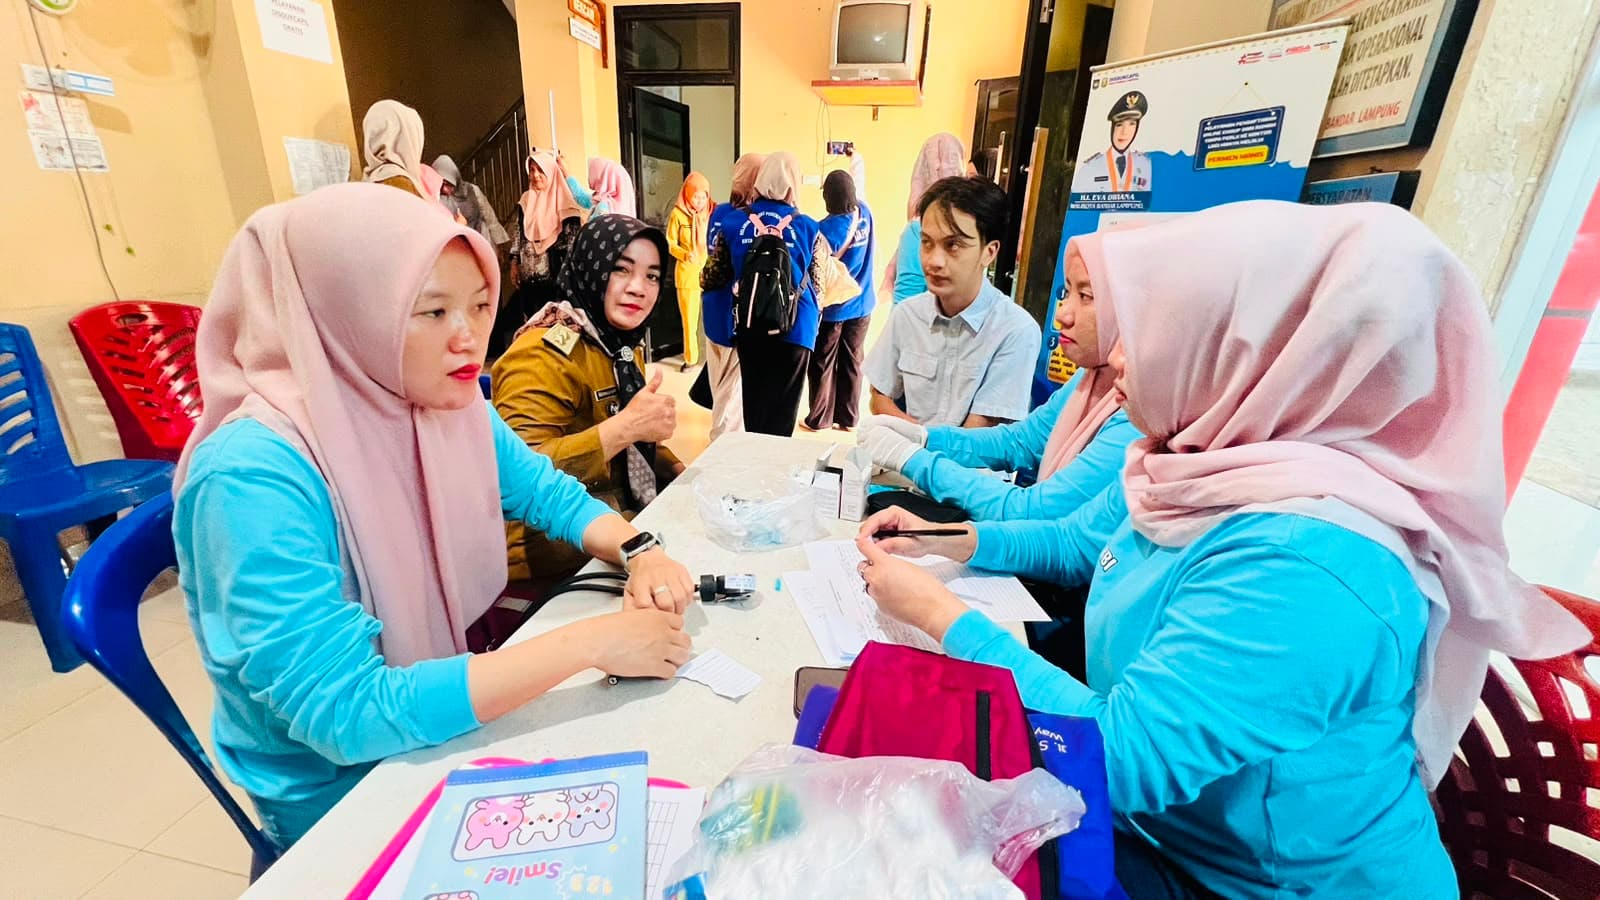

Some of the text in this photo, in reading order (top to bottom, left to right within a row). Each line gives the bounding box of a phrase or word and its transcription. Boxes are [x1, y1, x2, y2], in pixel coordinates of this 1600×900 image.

[1356, 14, 1428, 61] OPERASIONAL
[1358, 100, 1402, 123] LAMPUNG
[1307, 187, 1373, 205] ERSYARATAN
[1034, 727, 1065, 743] Way
[484, 861, 563, 886] Smile!
